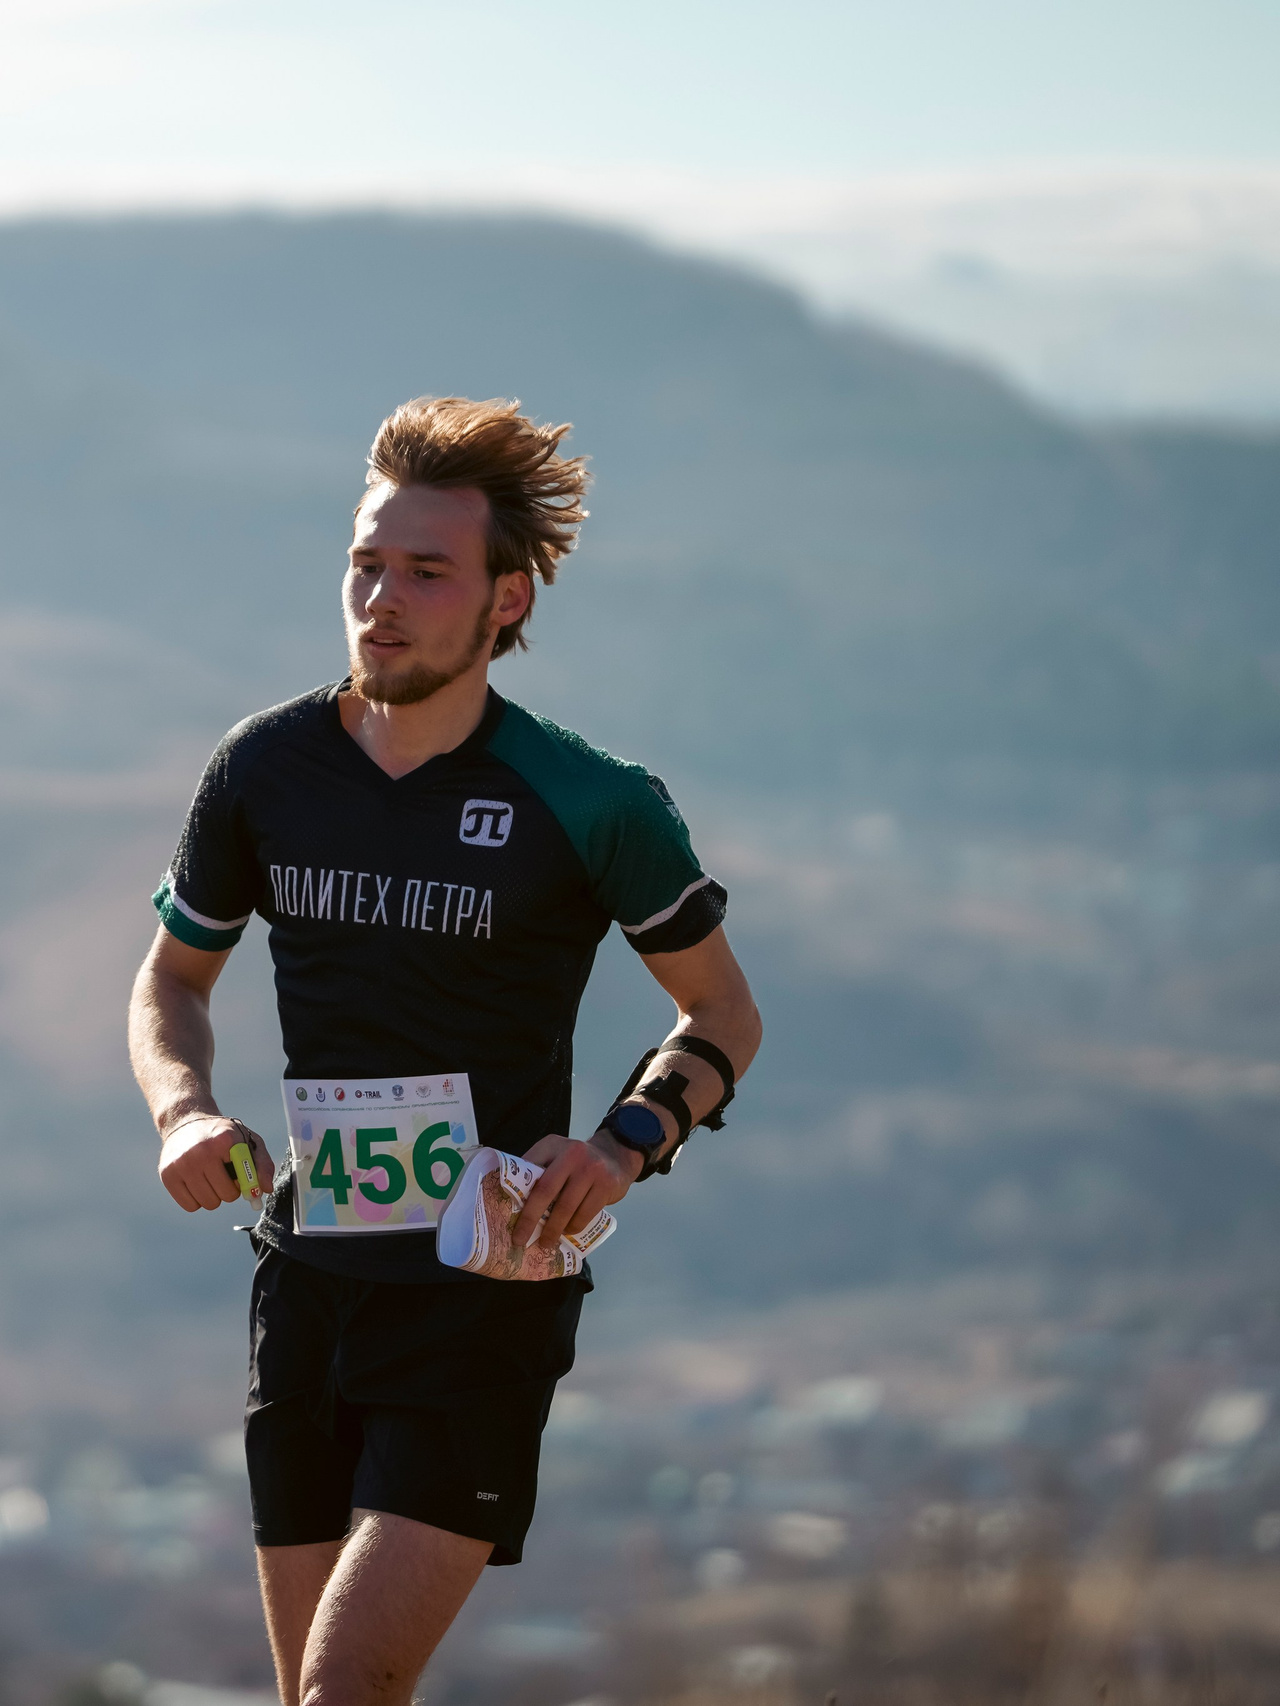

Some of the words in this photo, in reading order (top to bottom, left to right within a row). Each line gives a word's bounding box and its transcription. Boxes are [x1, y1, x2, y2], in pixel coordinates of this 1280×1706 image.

[270, 864, 392, 926] ПОЛИТЕХ
[401, 878, 493, 940] ПЕТРА
[309, 1120, 466, 1205] 456
